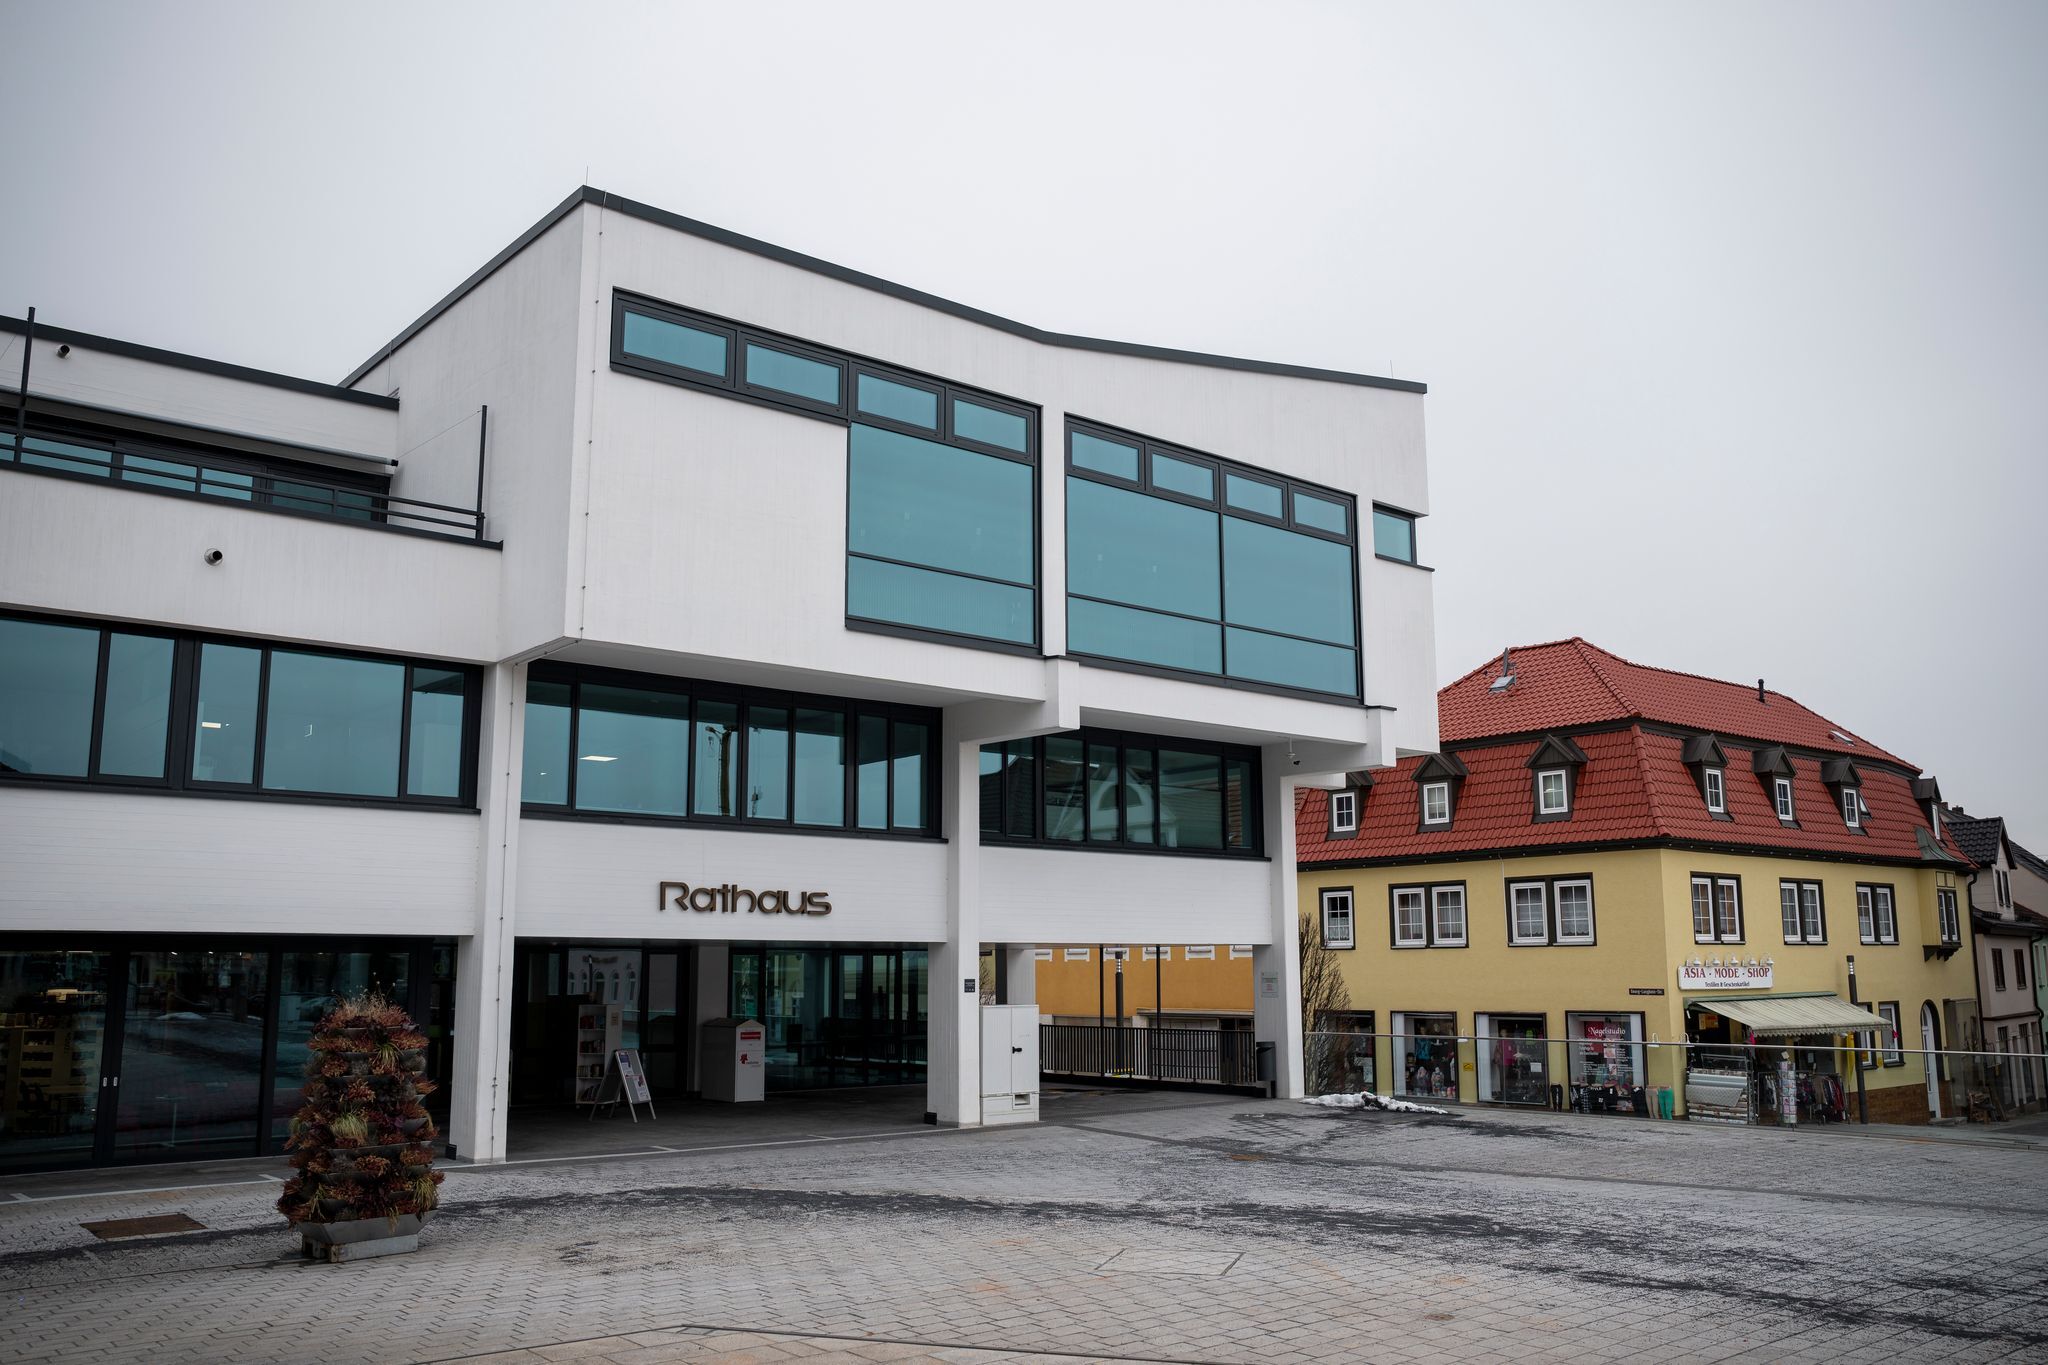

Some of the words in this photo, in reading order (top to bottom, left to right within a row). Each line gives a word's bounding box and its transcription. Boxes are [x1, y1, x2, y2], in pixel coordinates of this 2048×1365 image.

[659, 881, 832, 916] Rathaus
[1684, 967, 1706, 978] ASIA
[1714, 967, 1740, 978] MODE
[1747, 967, 1770, 978] SHOP
[1588, 1026, 1626, 1037] Nagelstudio
